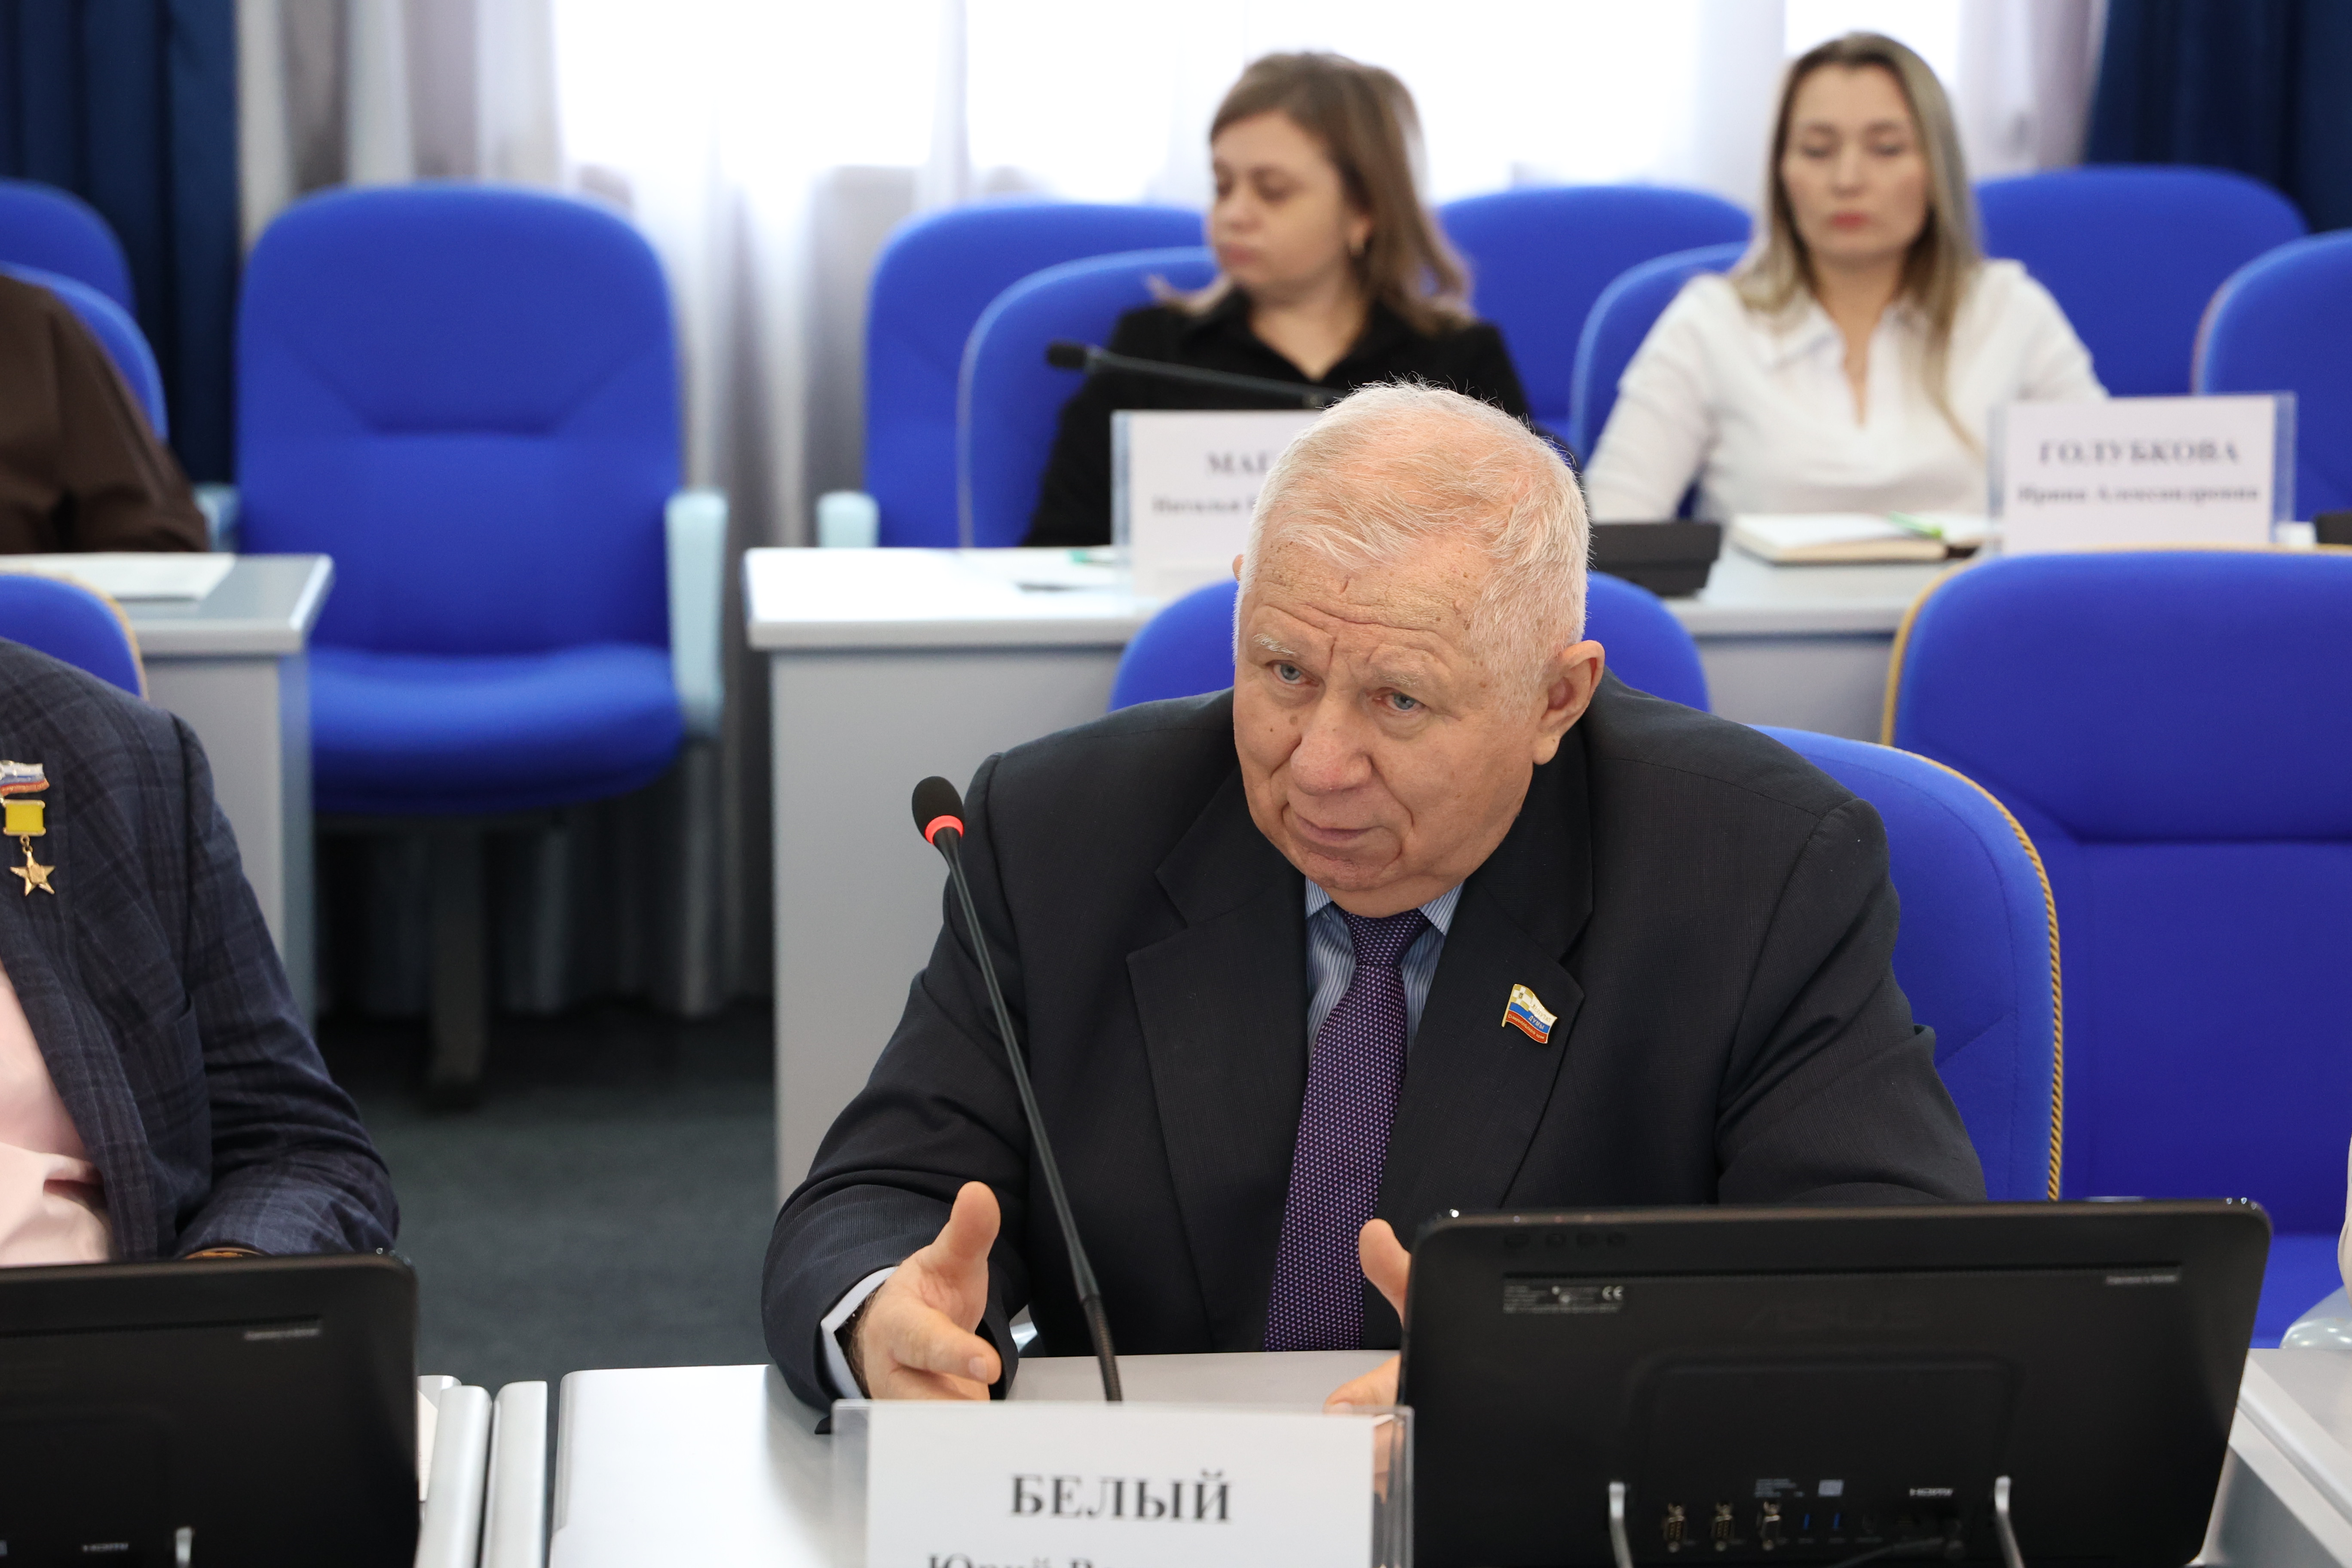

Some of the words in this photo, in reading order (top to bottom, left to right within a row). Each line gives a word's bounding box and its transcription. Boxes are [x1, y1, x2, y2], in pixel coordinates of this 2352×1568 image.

[2038, 439, 2241, 465] ГОЛУБКОВА
[1528, 1016, 1545, 1029] ДУМЫ
[1011, 1470, 1232, 1523] БЕЛЫЙ
